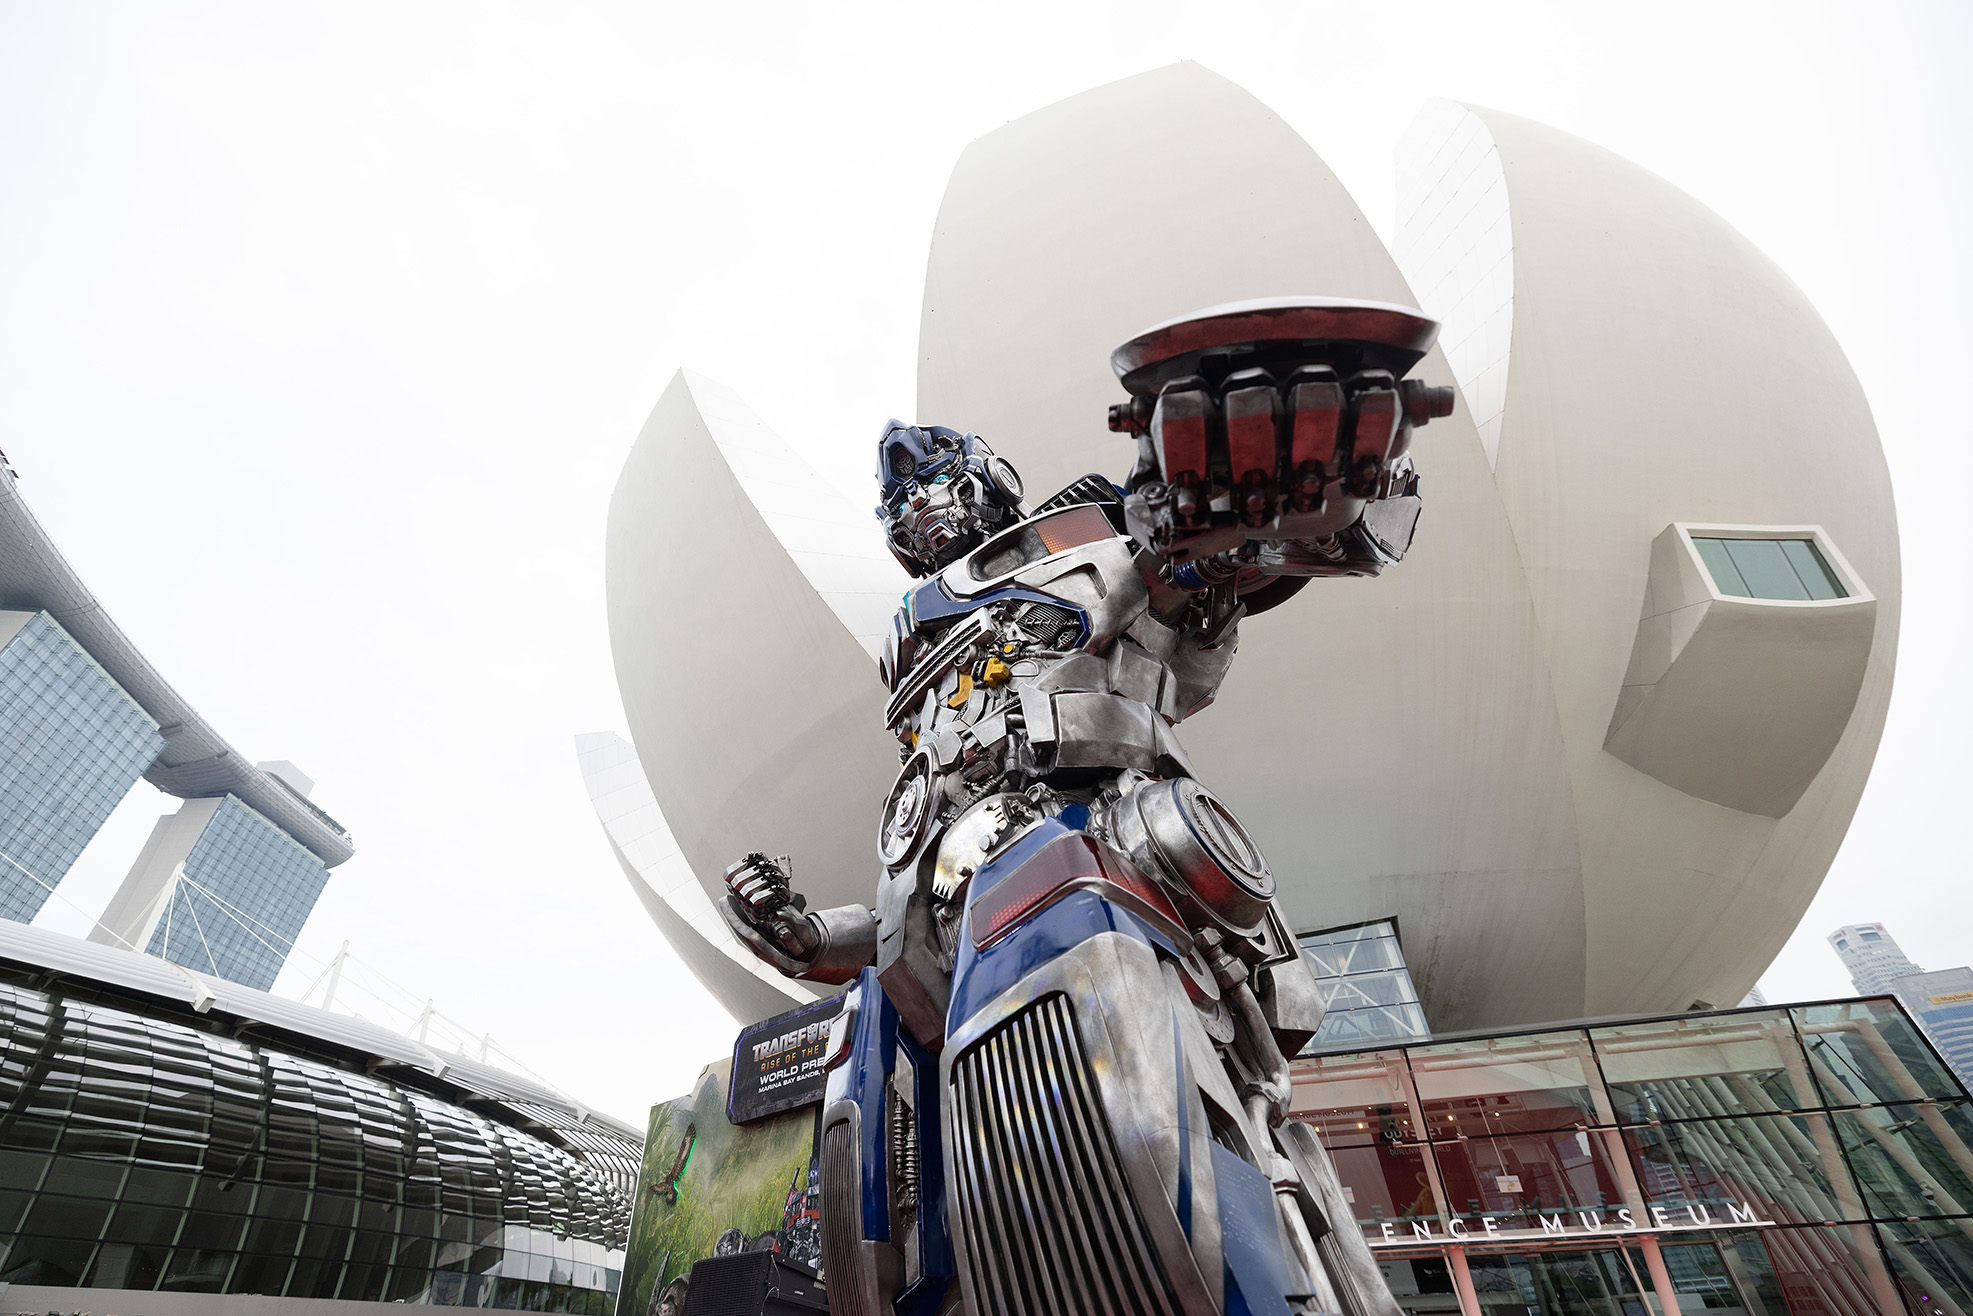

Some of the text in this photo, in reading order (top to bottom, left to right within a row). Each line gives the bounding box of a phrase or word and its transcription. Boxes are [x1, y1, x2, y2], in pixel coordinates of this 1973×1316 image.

[1940, 992, 1972, 1001] Maybank
[752, 1019, 833, 1062] TRANSFOR
[761, 1058, 780, 1072] RISE
[785, 1053, 797, 1063] OF
[802, 1044, 819, 1058] THE
[760, 1065, 799, 1085] WORLD
[758, 1082, 782, 1094] MARINA
[783, 1077, 796, 1086] BAY
[1384, 1127, 1443, 1139] ODYSEY
[1405, 1147, 1421, 1156] LIVIN
[1359, 1217, 1501, 1243] ENCE
[1538, 1201, 1758, 1236] MUSEUM
